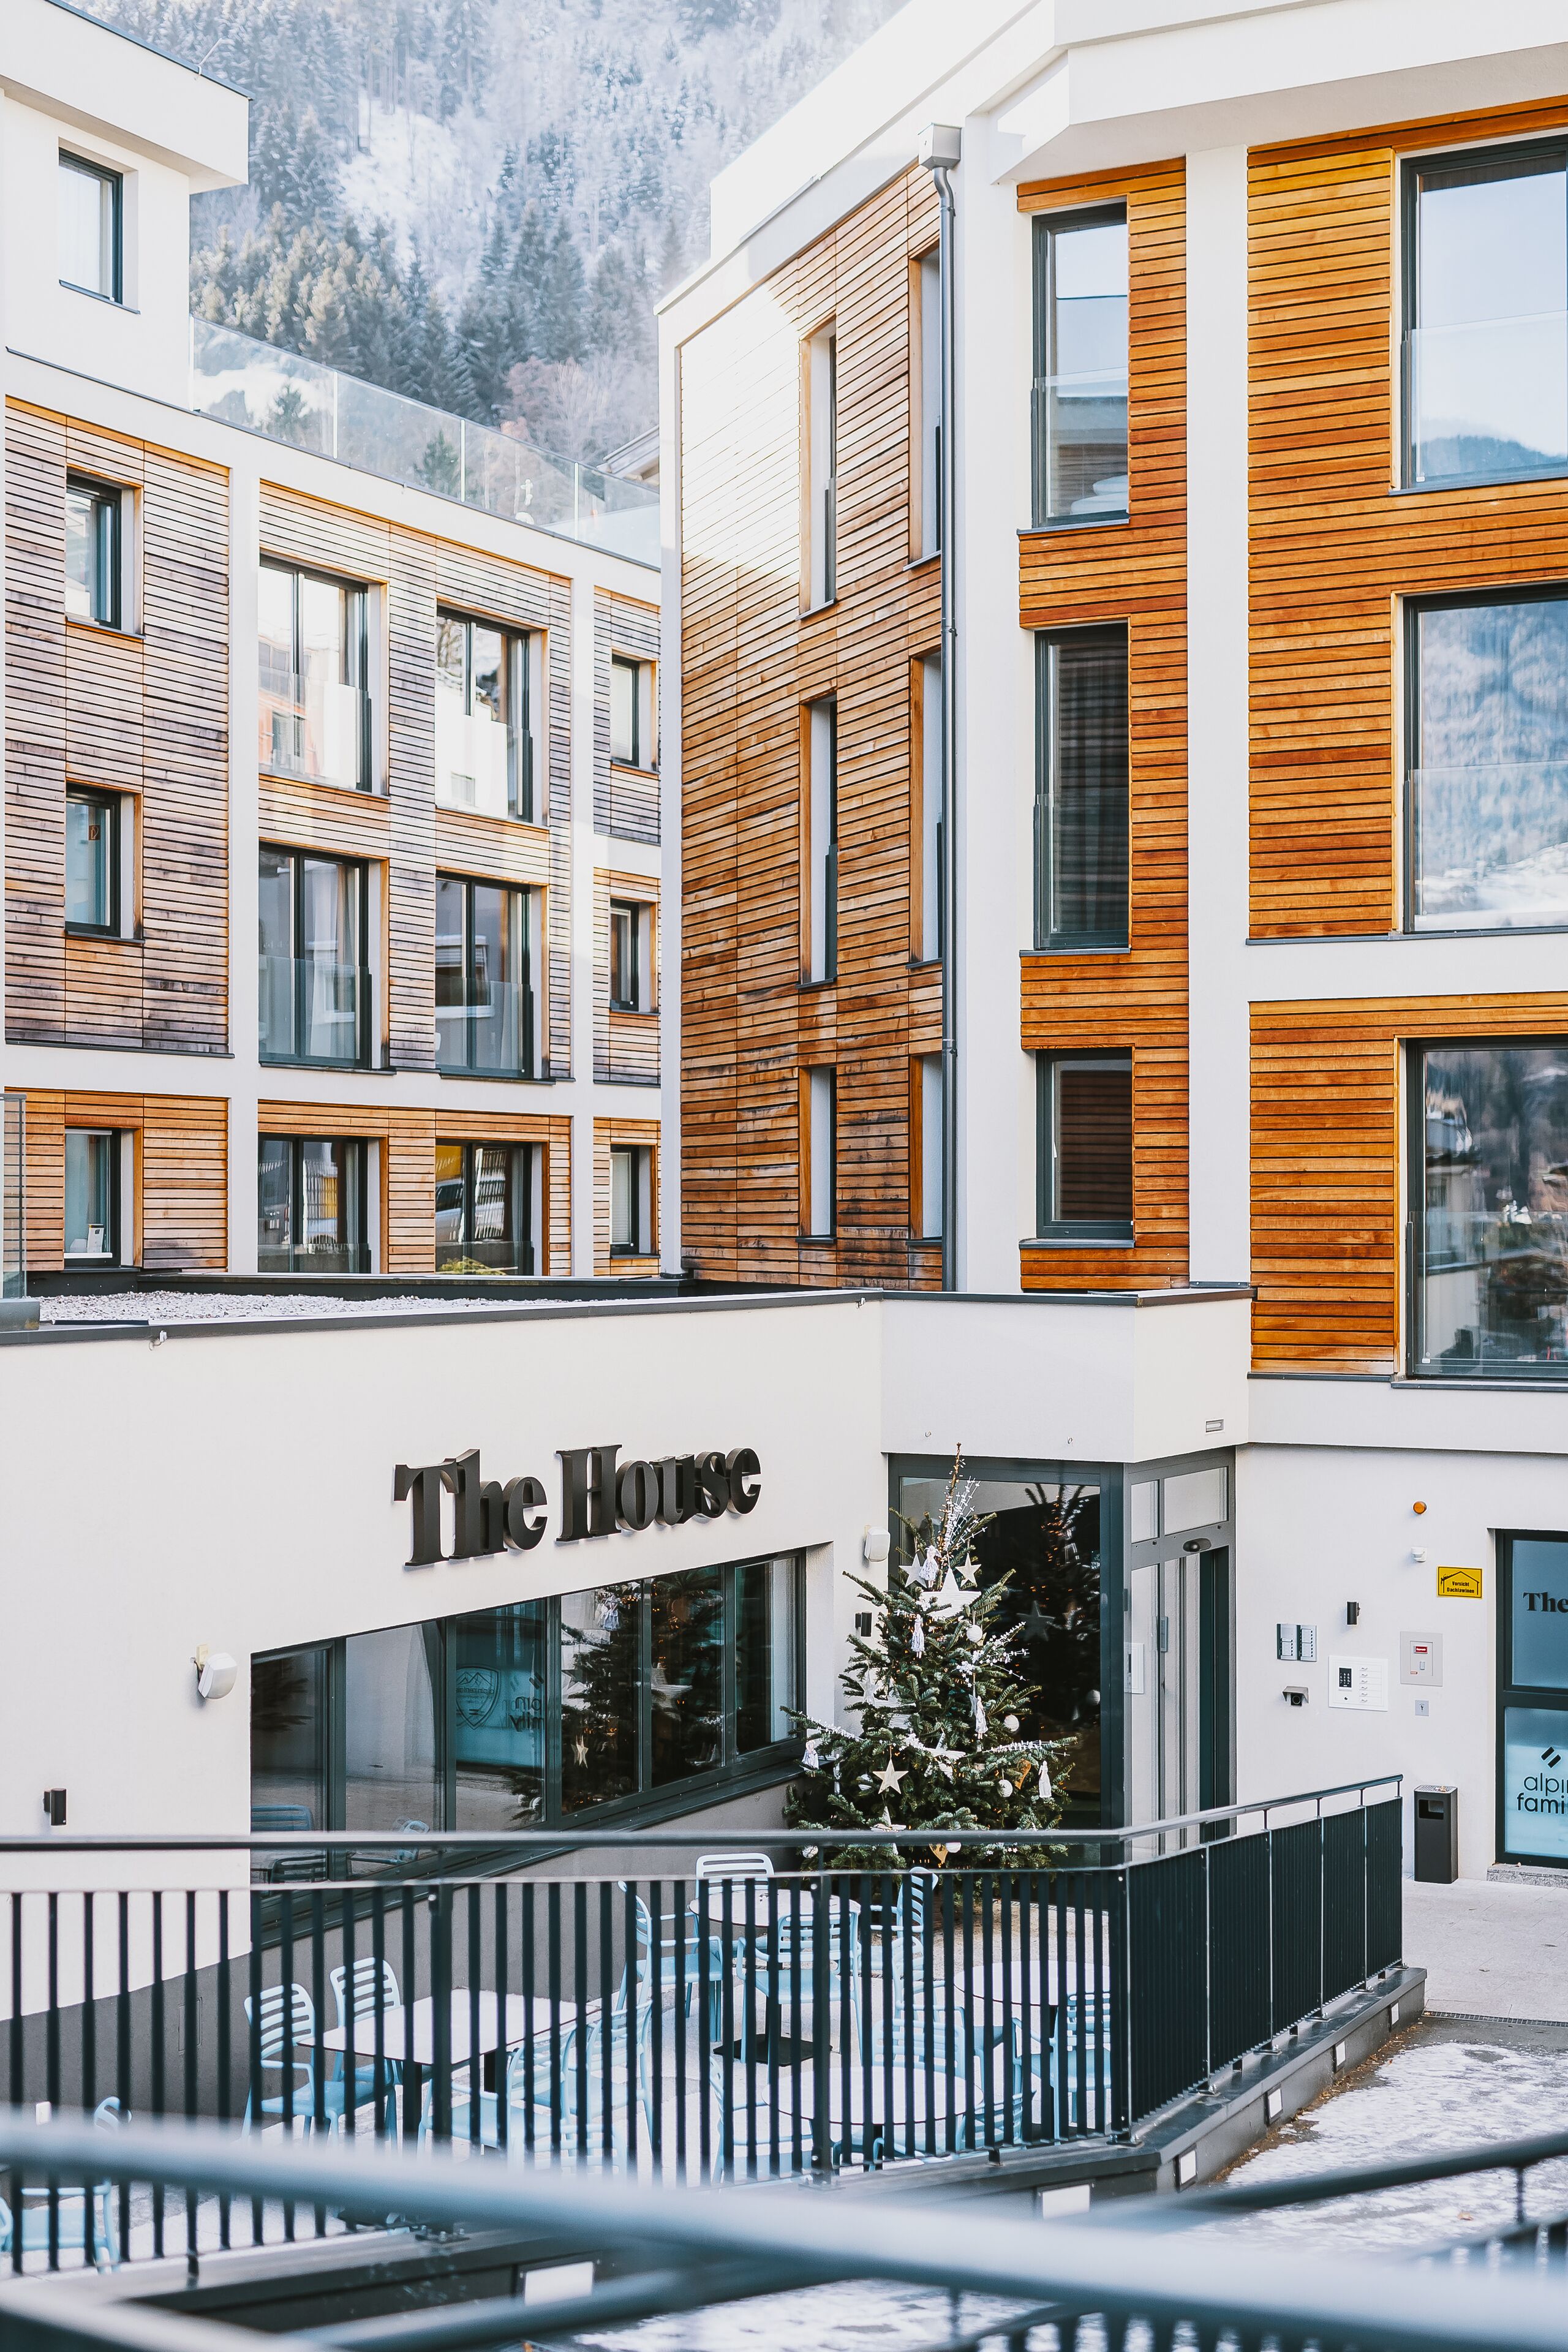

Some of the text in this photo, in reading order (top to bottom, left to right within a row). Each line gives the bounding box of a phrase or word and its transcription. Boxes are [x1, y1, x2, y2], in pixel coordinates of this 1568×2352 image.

[394, 1444, 761, 1566] The House
[1523, 1591, 1568, 1613] The
[1523, 1772, 1568, 1796] alpi
[1517, 1792, 1568, 1815] fami
